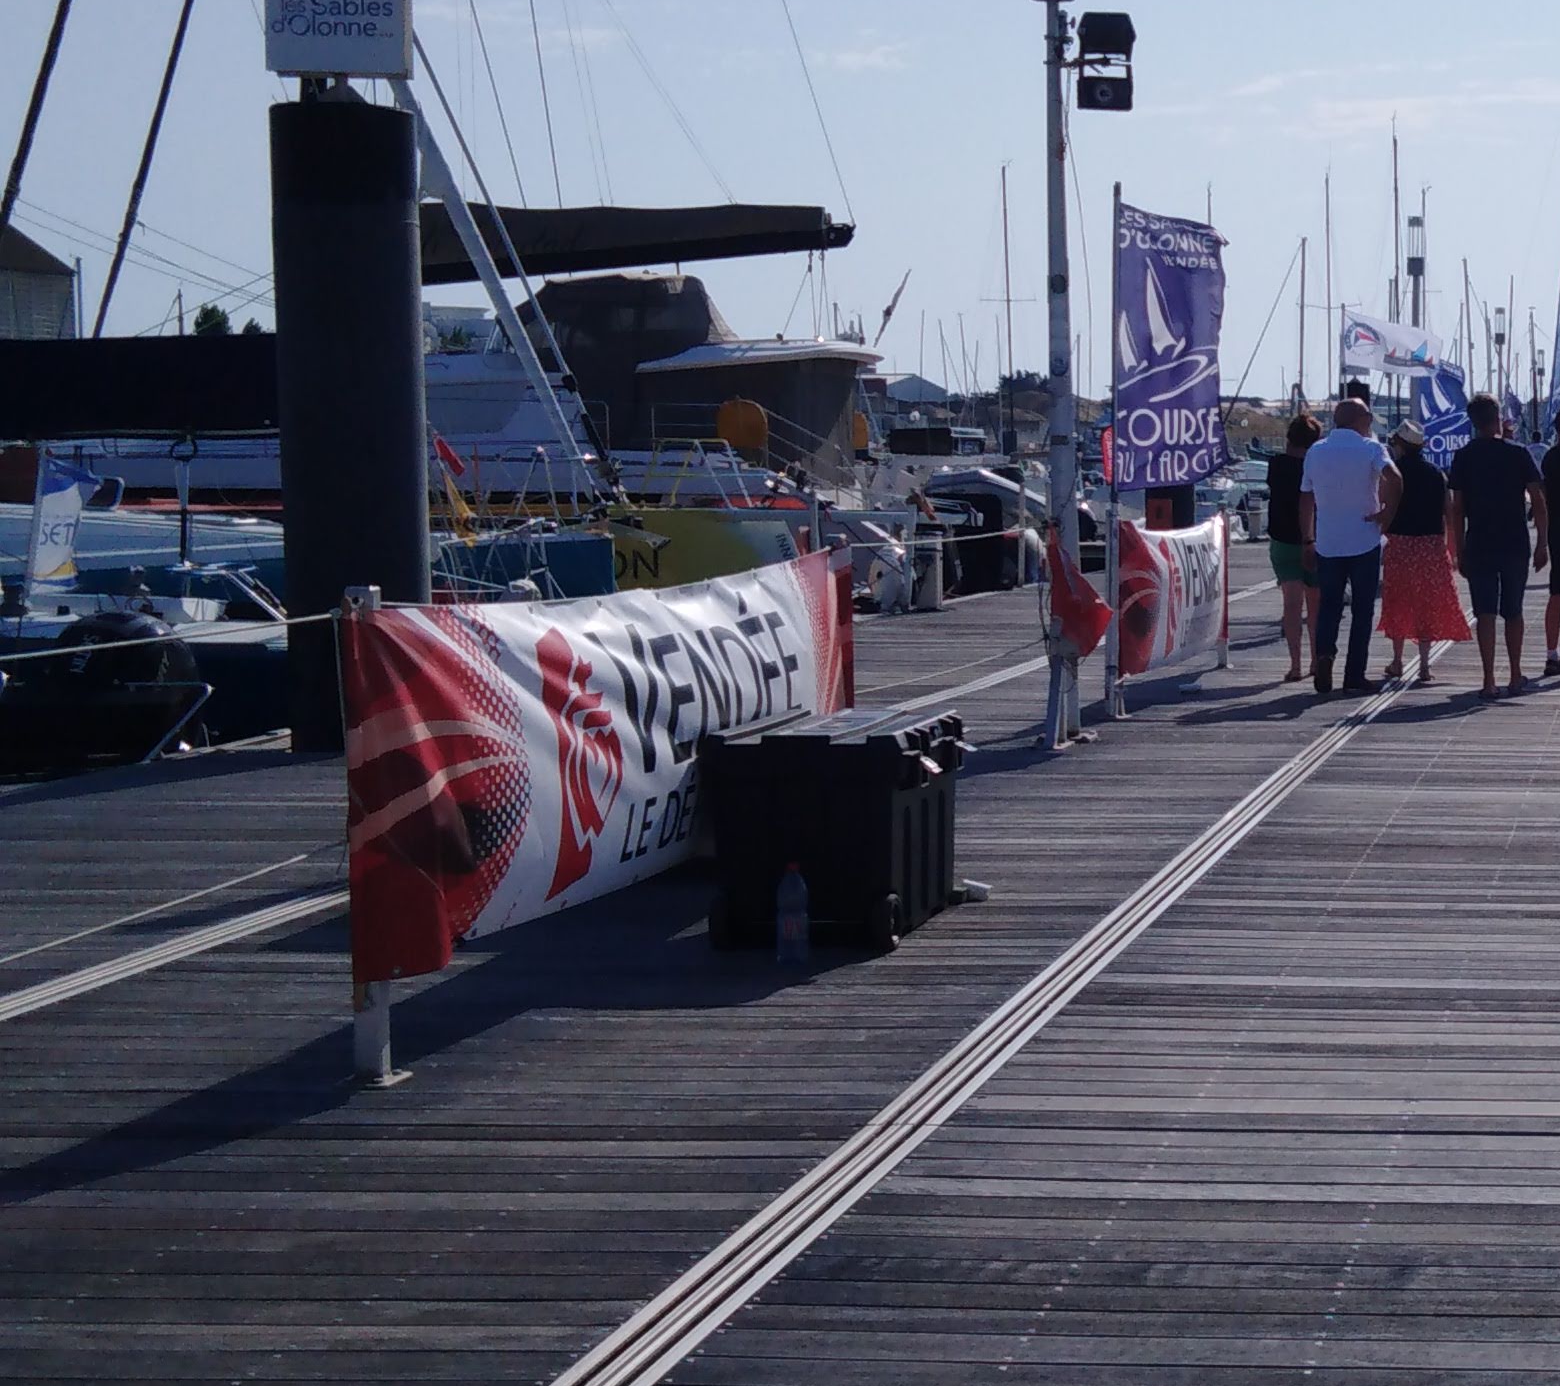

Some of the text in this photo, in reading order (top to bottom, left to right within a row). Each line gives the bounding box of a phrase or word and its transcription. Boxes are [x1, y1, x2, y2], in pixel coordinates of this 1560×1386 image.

[271, 14, 378, 37] d'Olonne
[1146, 445, 1223, 483] LARGE
[582, 591, 803, 773] VENDÉE
[619, 771, 698, 863] LE DÉ
